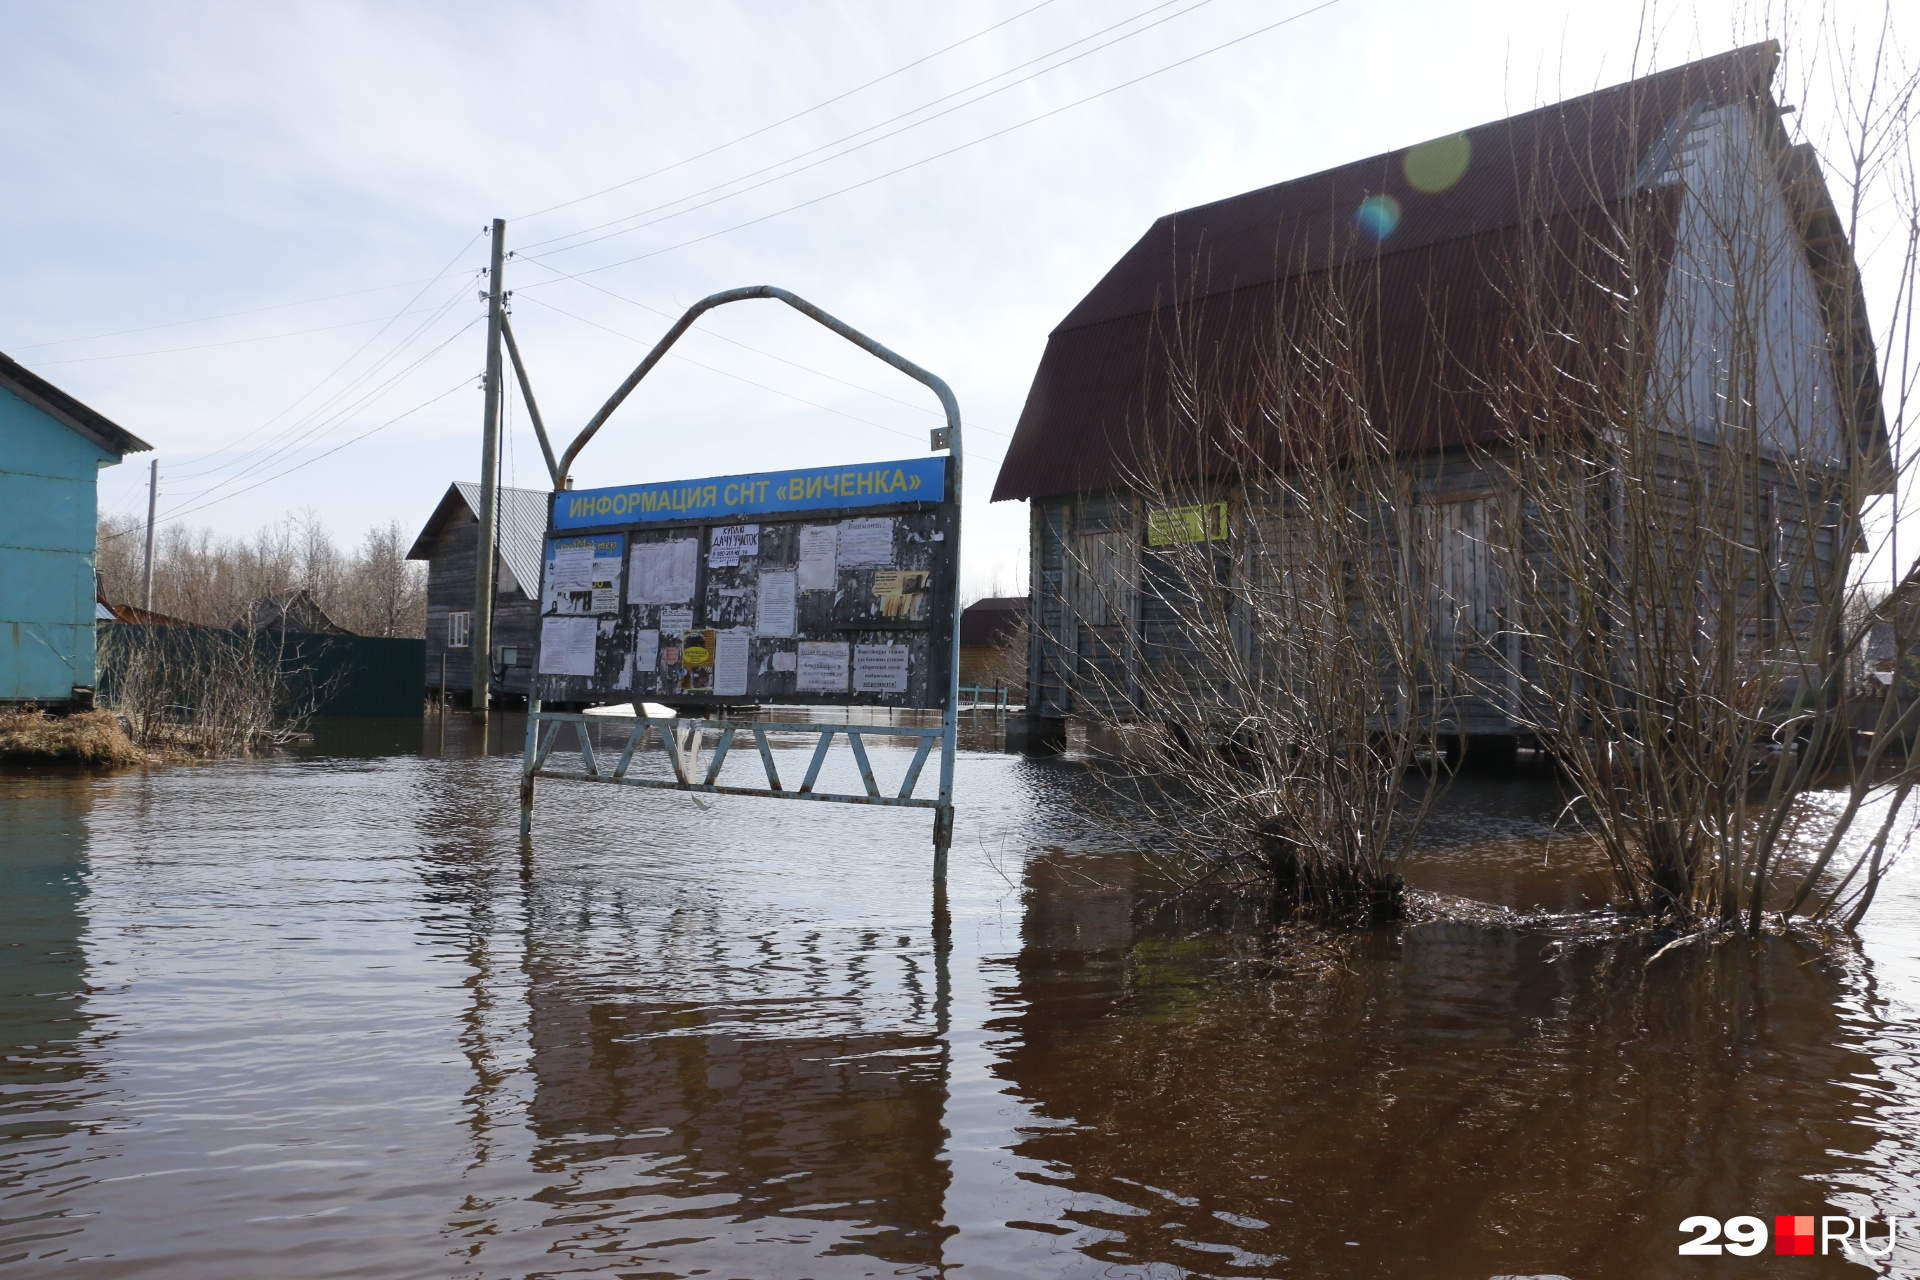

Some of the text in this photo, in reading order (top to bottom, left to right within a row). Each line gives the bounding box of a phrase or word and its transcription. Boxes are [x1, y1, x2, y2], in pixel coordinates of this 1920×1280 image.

[569, 468, 922, 518] ИНФОРМАЦИЯ СНТ «ВИЧЕНКА»
[722, 525, 745, 535] КУПЛЮ
[848, 520, 886, 530] Внимание!
[713, 533, 758, 546] ДАЧУ УЧАСТОК
